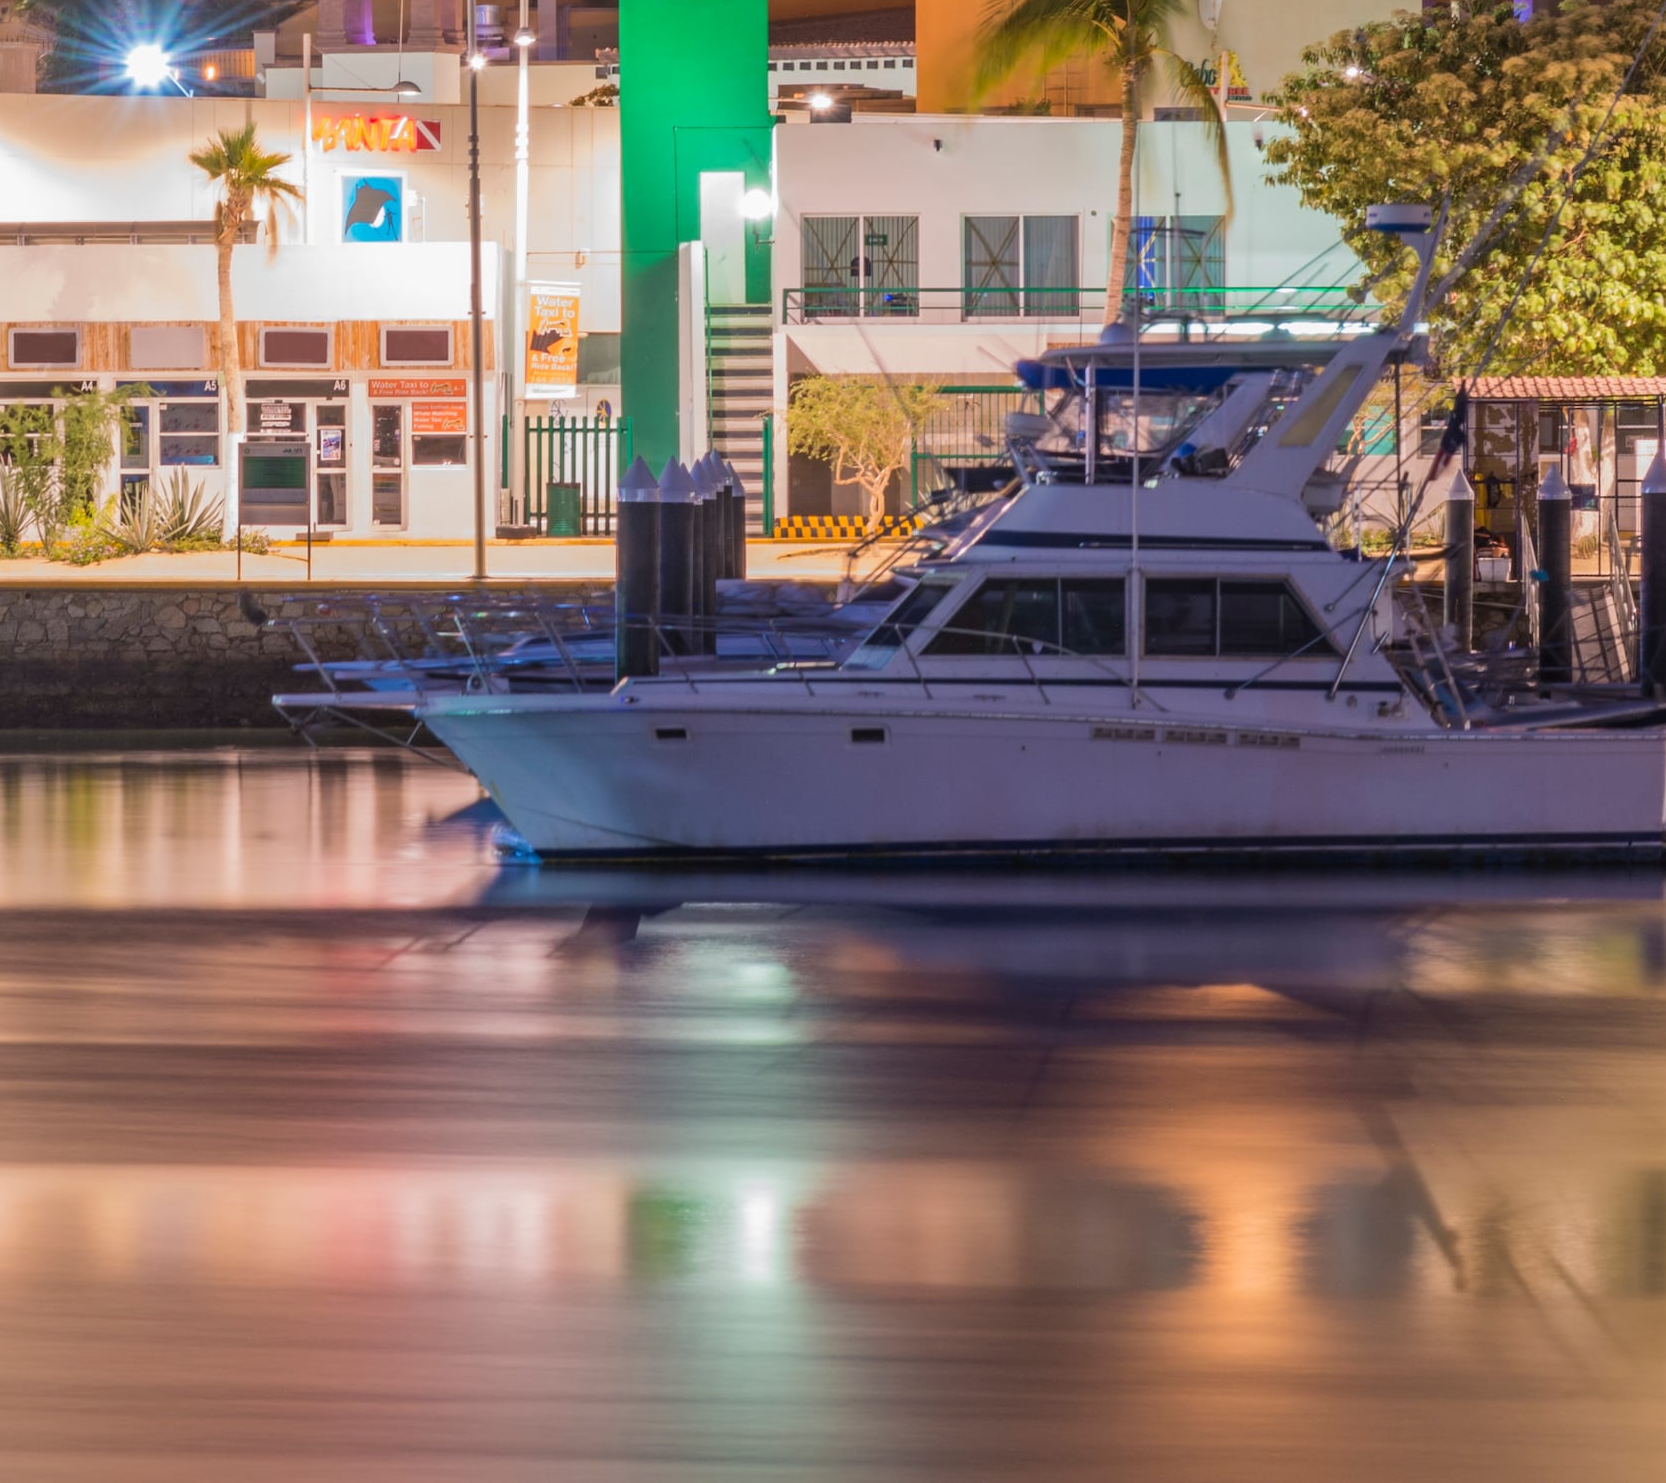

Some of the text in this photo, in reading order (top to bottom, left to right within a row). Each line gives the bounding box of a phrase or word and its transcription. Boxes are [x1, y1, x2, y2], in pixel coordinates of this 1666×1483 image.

[311, 115, 418, 152] MANTA
[537, 297, 573, 307] Water
[535, 306, 575, 318] Taxi to
[541, 354, 565, 363] Free
[81, 381, 93, 391] A4
[204, 381, 217, 391] A5
[334, 380, 346, 390] A6
